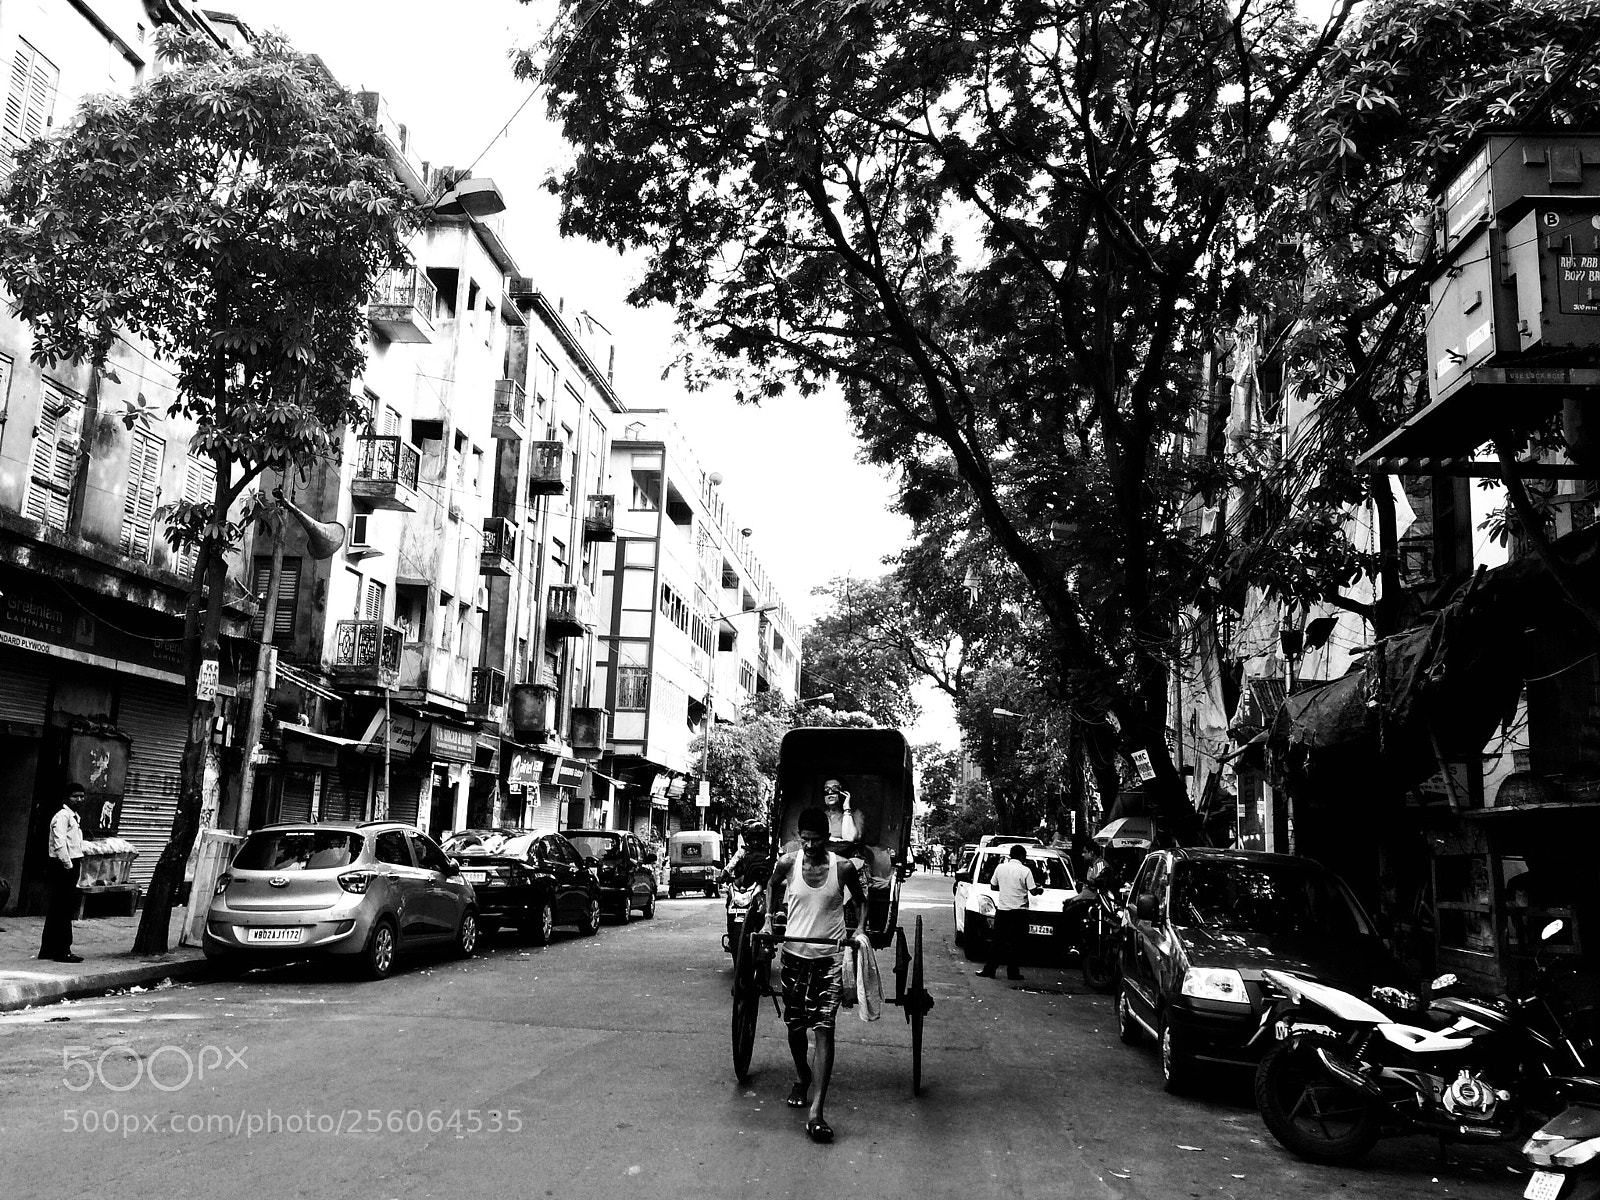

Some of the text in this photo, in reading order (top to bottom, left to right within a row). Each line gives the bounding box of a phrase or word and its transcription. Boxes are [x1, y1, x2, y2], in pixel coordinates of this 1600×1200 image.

[1546, 214, 1558, 226] B
[7, 592, 63, 623] Greenlam
[22, 639, 50, 653] PLYWOOD
[154, 635, 183, 654] Greenl
[202, 686, 215, 696] ZO
[1134, 752, 1147, 762] KMC
